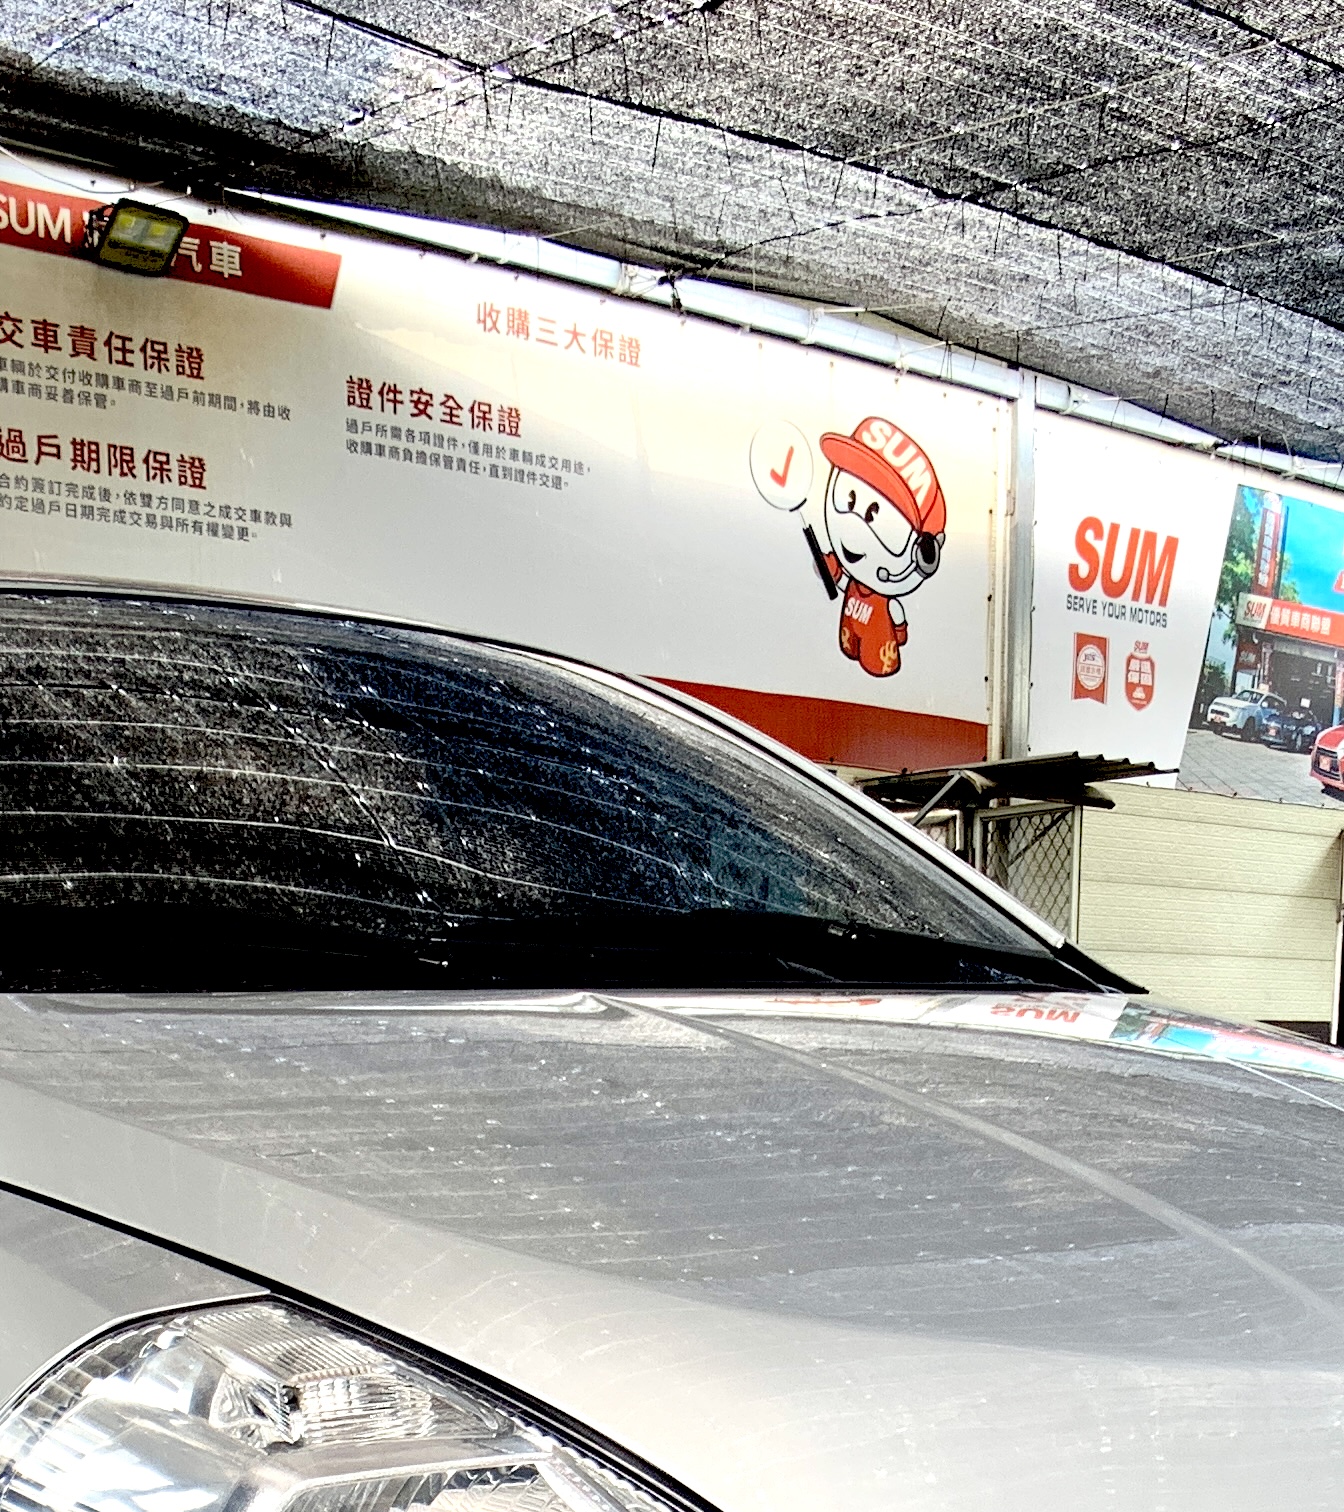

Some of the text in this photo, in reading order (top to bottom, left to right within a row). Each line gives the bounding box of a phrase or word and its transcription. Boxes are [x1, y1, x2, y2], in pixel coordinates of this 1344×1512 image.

[476, 301, 642, 368] 收購三大保證
[346, 374, 522, 439] 證件安全保證
[861, 420, 933, 509] SUM
[1068, 516, 1180, 608] SUM
[843, 596, 874, 626] SUM
[1066, 594, 1168, 629] SERVE YOUR MOTORS
[1244, 600, 1267, 619] SUM
